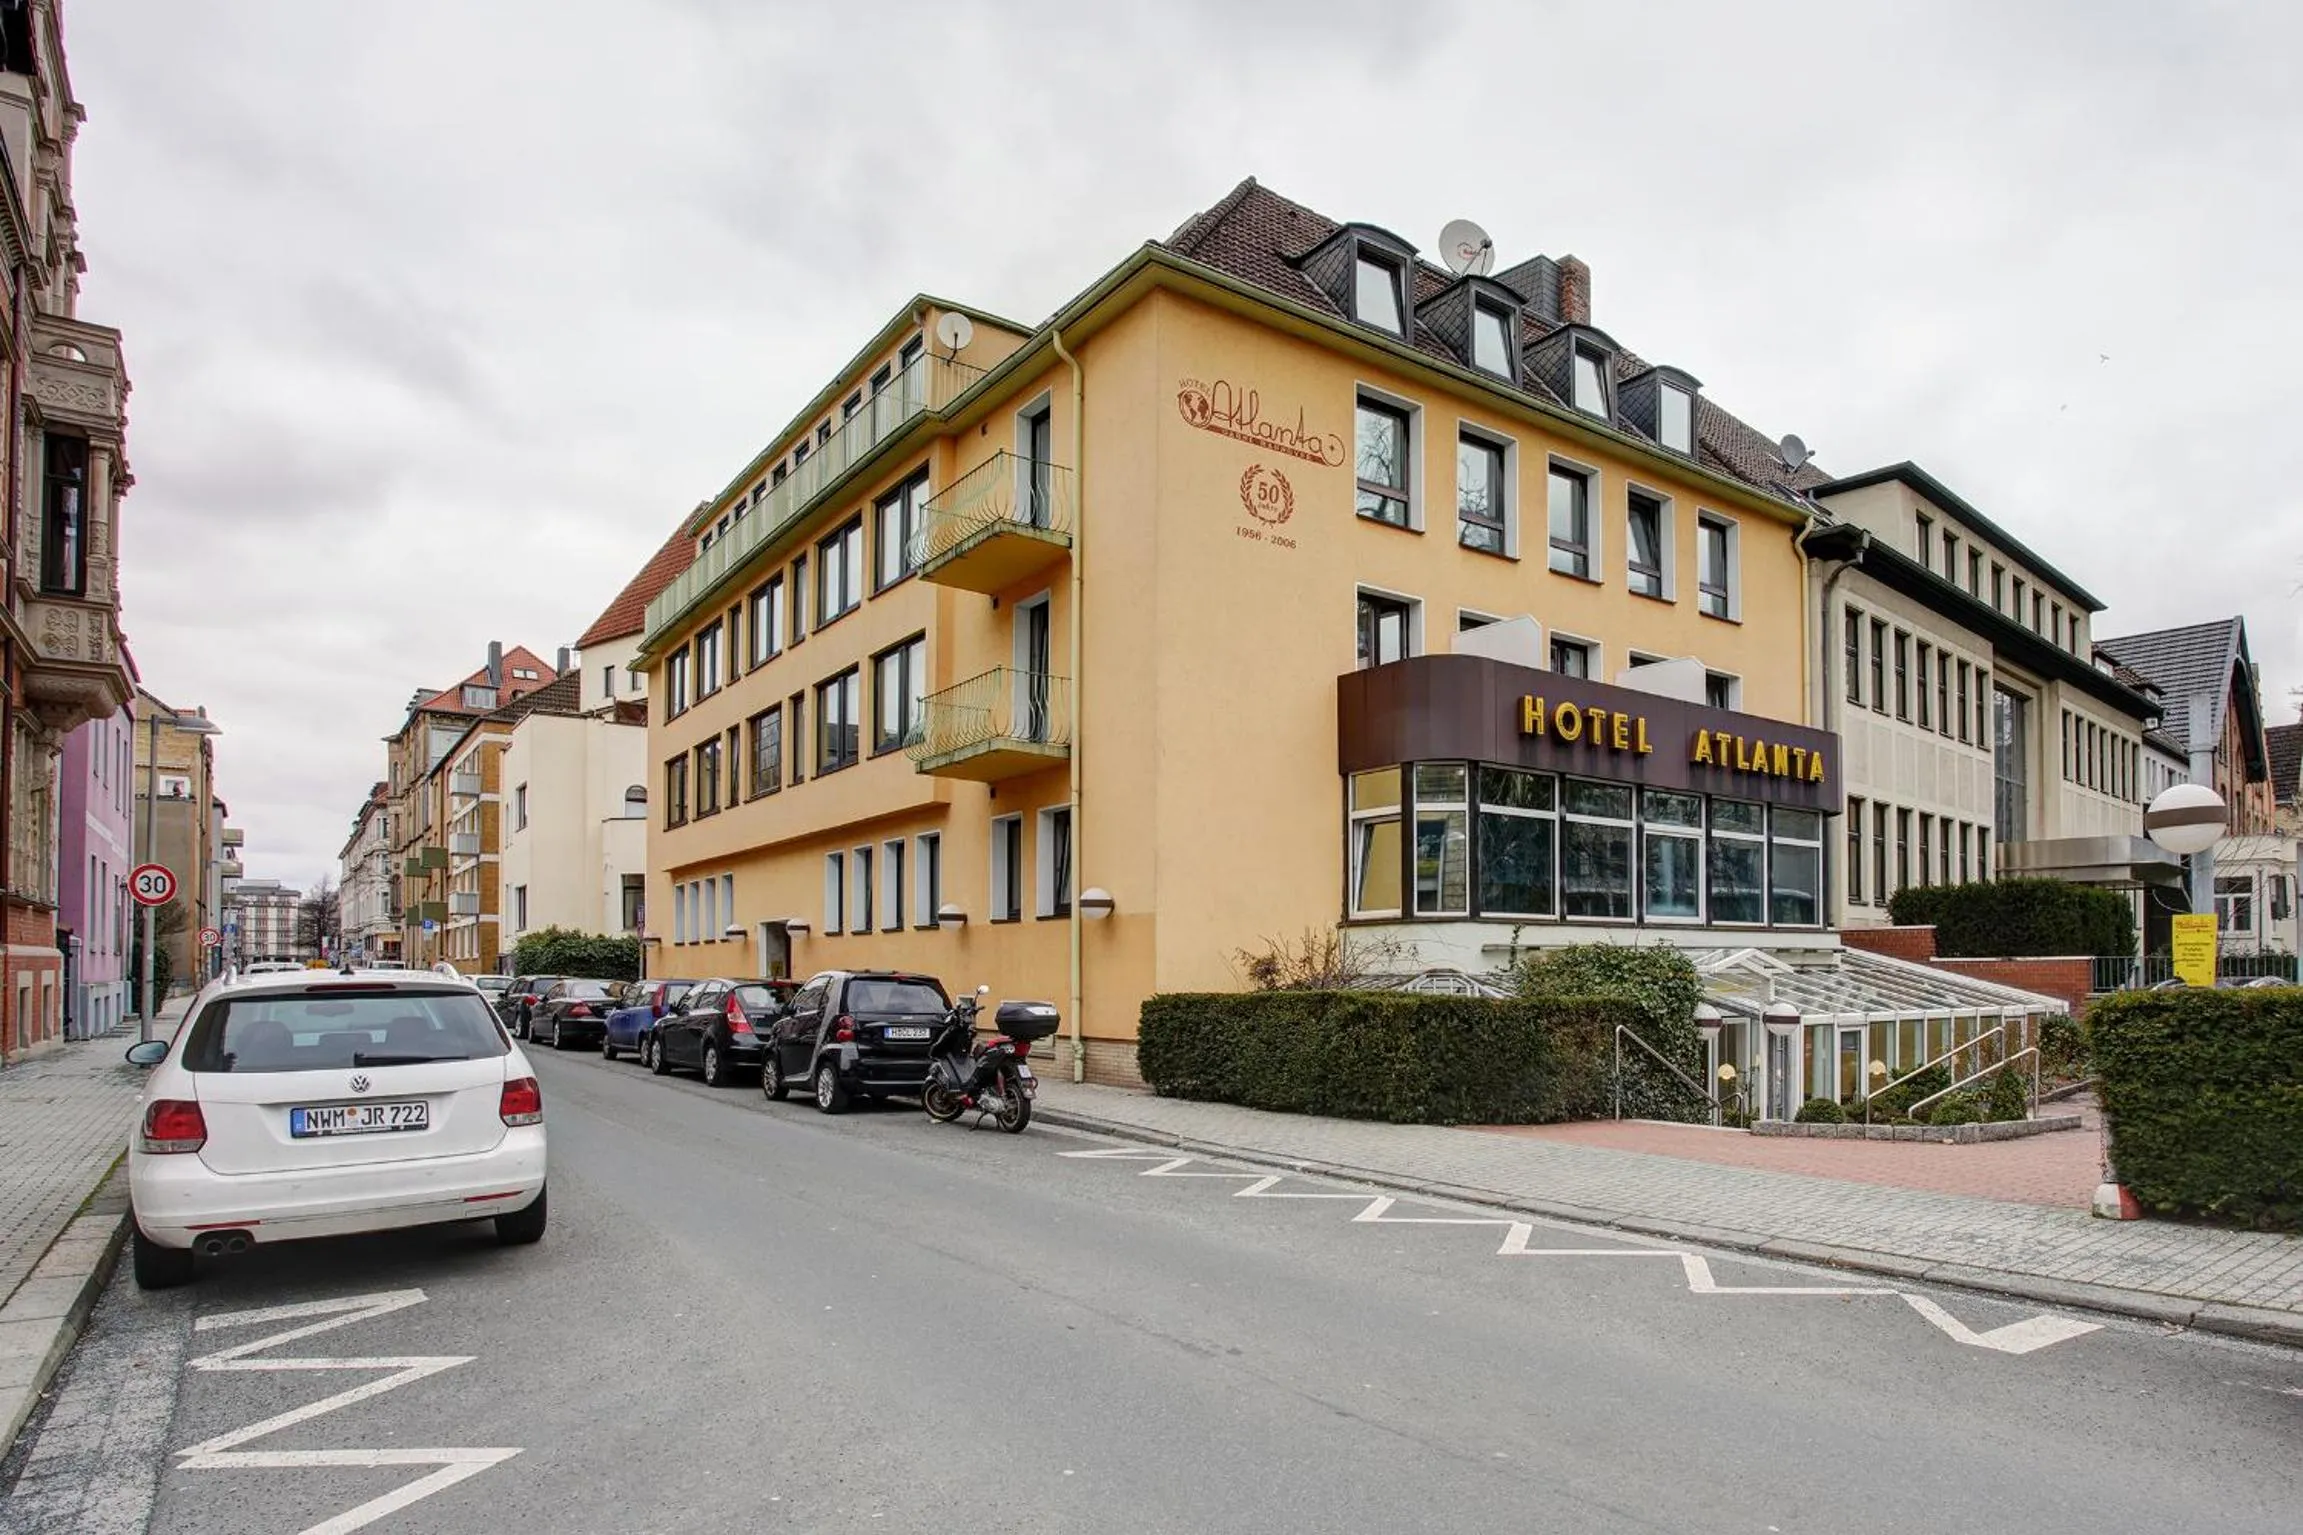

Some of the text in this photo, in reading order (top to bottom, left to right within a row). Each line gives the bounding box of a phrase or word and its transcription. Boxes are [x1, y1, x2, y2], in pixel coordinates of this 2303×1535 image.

[1178, 379, 1211, 396] HOTEL
[1211, 380, 1322, 454] Atlanta
[1258, 481, 1280, 504] 50
[1236, 526, 1262, 541] 1956
[1270, 535, 1297, 549] 2006
[1519, 694, 1826, 783] HOTEL ATLANTA
[139, 875, 167, 894] 30
[203, 932, 216, 943] 30
[305, 1104, 426, 1129] NWM JR 722
